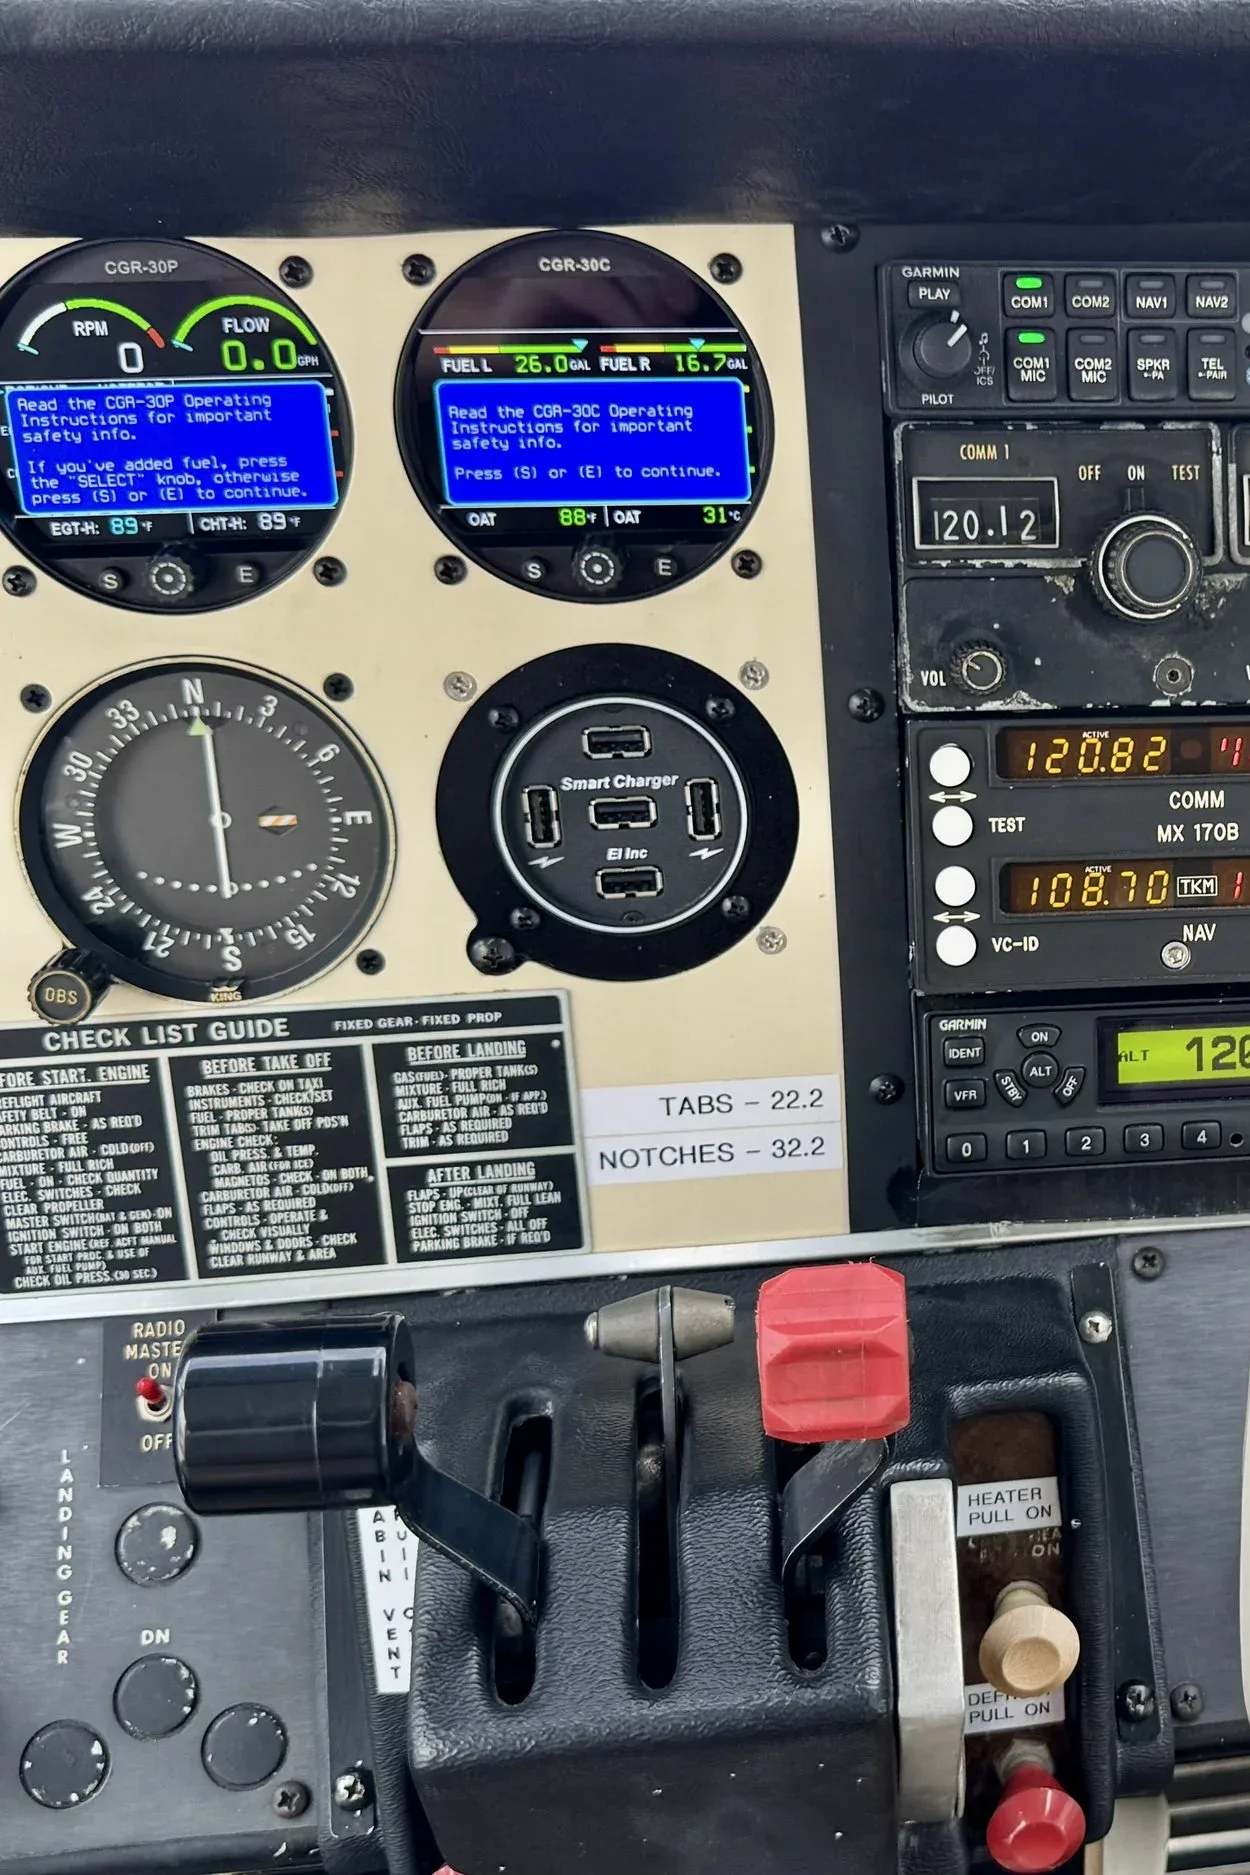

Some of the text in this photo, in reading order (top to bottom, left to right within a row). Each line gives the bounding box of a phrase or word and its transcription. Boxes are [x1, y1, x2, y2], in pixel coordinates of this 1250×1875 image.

[104, 261, 179, 275] CGR-30P
[539, 258, 611, 272] CGR-30C
[902, 268, 960, 279] GARMIN
[919, 289, 951, 300] PLAY
[1011, 297, 1048, 308] COM1
[1072, 297, 1110, 308] COM2
[1196, 297, 1228, 308] NAV2
[1136, 298, 1167, 309] NAV1
[72, 321, 108, 336] RPM
[222, 318, 269, 333] FLOW
[221, 339, 319, 371] 0.0 GPH
[442, 359, 492, 372] FUEL L
[514, 355, 591, 373] 26.0 GAL
[1137, 359, 1170, 371] SPKR
[1202, 358, 1224, 370] TEL
[18, 394, 272, 412] Read the CGR-30P Operating
[21, 409, 271, 428] Instructions for important
[23, 428, 137, 444] safety info.
[960, 444, 1009, 460] COMM 1
[28, 456, 288, 475] If you've added fuel, press
[1078, 466, 1101, 481] OFF
[1127, 466, 1145, 480] ON
[1172, 465, 1200, 480] TEST
[32, 476, 59, 489] the
[157, 472, 201, 487] knob,
[214, 471, 299, 483] otherwise
[32, 486, 308, 506] press (S) or (E) to continue.
[468, 512, 496, 526] OAT
[559, 508, 587, 526] 88
[933, 505, 1037, 541] 120.12
[920, 670, 946, 686] VOL
[181, 678, 205, 705] N
[105, 699, 141, 729] 33
[1027, 736, 1167, 774] 120.82
[560, 774, 679, 791] Smart Charger
[1169, 791, 1225, 809] COMM
[989, 818, 1025, 832] TEST
[1157, 823, 1239, 842] MX 170B
[625, 847, 648, 859] Inc
[1030, 870, 1170, 908] 108.70
[1181, 879, 1214, 894] TKM
[1182, 924, 1216, 942] NAV
[992, 937, 1039, 952] VC-ID
[45, 987, 78, 1004] OBS
[939, 1018, 986, 1031] GARMIN
[42, 1018, 290, 1052] CHECK LIST GUIDE
[1031, 1032, 1048, 1042] ON
[408, 1040, 526, 1062] BEFORE LANDING
[949, 1047, 981, 1059] IDENT
[1029, 1066, 1052, 1077] ALT
[659, 1088, 823, 1116] TABS 22.2
[954, 1090, 977, 1100] VFR
[600, 1137, 825, 1170] NOTCHES 32.2
[426, 1162, 536, 1183] AFTER LANDING
[4, 1200, 104, 1216] CLEAR PROPELLER
[133, 1320, 186, 1339] RADIO
[125, 1340, 184, 1359] MASTE
[968, 1487, 1042, 1506] HEATER
[968, 1505, 1052, 1526] PULL ON
[56, 1449, 74, 1664] LANDING GEAR
[141, 1628, 171, 1646] DN
